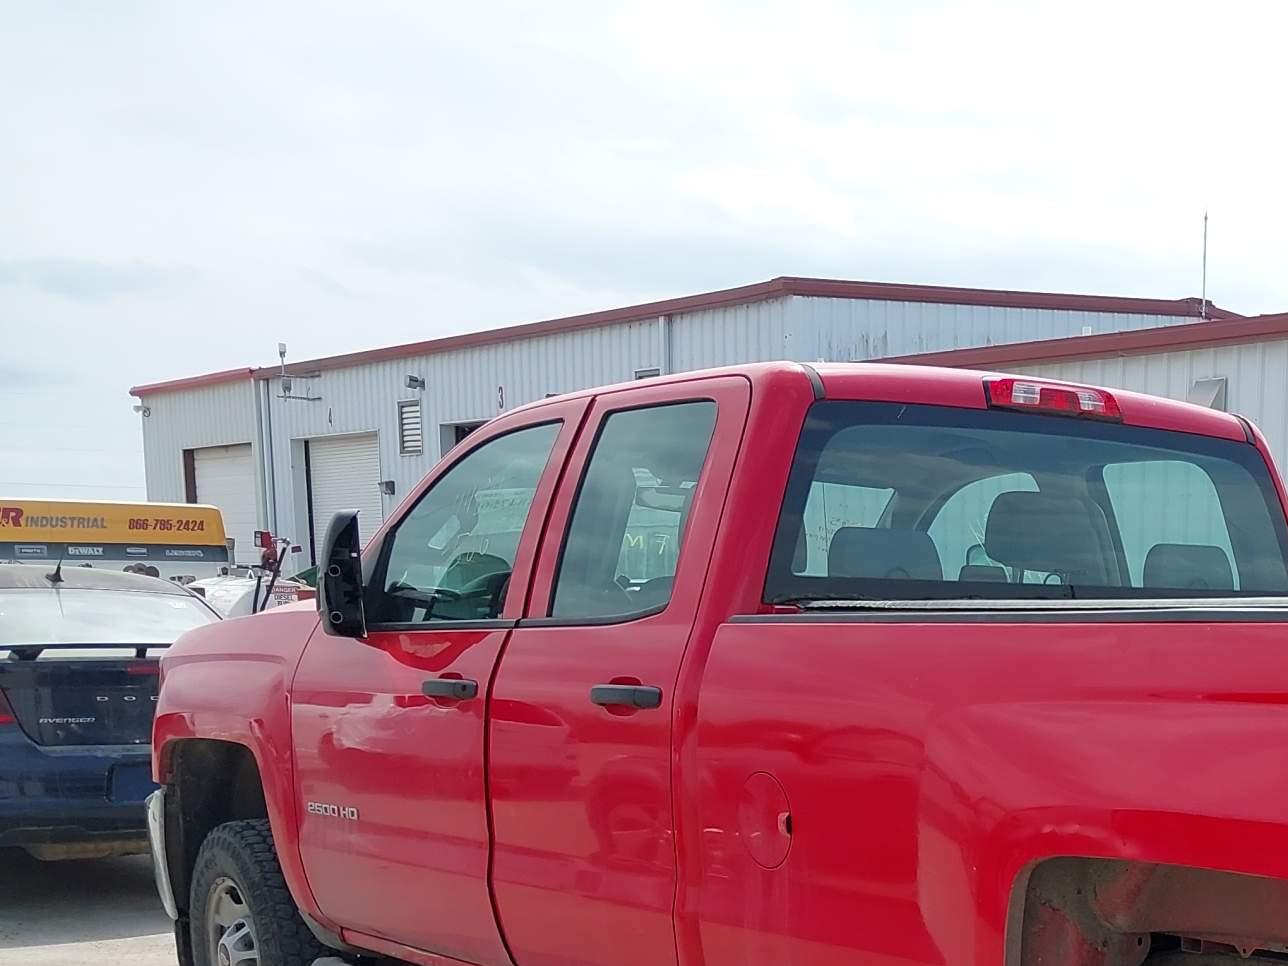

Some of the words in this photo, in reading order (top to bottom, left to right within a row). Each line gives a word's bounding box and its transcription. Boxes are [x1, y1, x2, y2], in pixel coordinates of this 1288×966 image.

[498, 385, 504, 409] 3
[25, 515, 107, 529] INDUSTRIAL
[307, 802, 338, 817] 2500
[340, 806, 359, 821] HD
